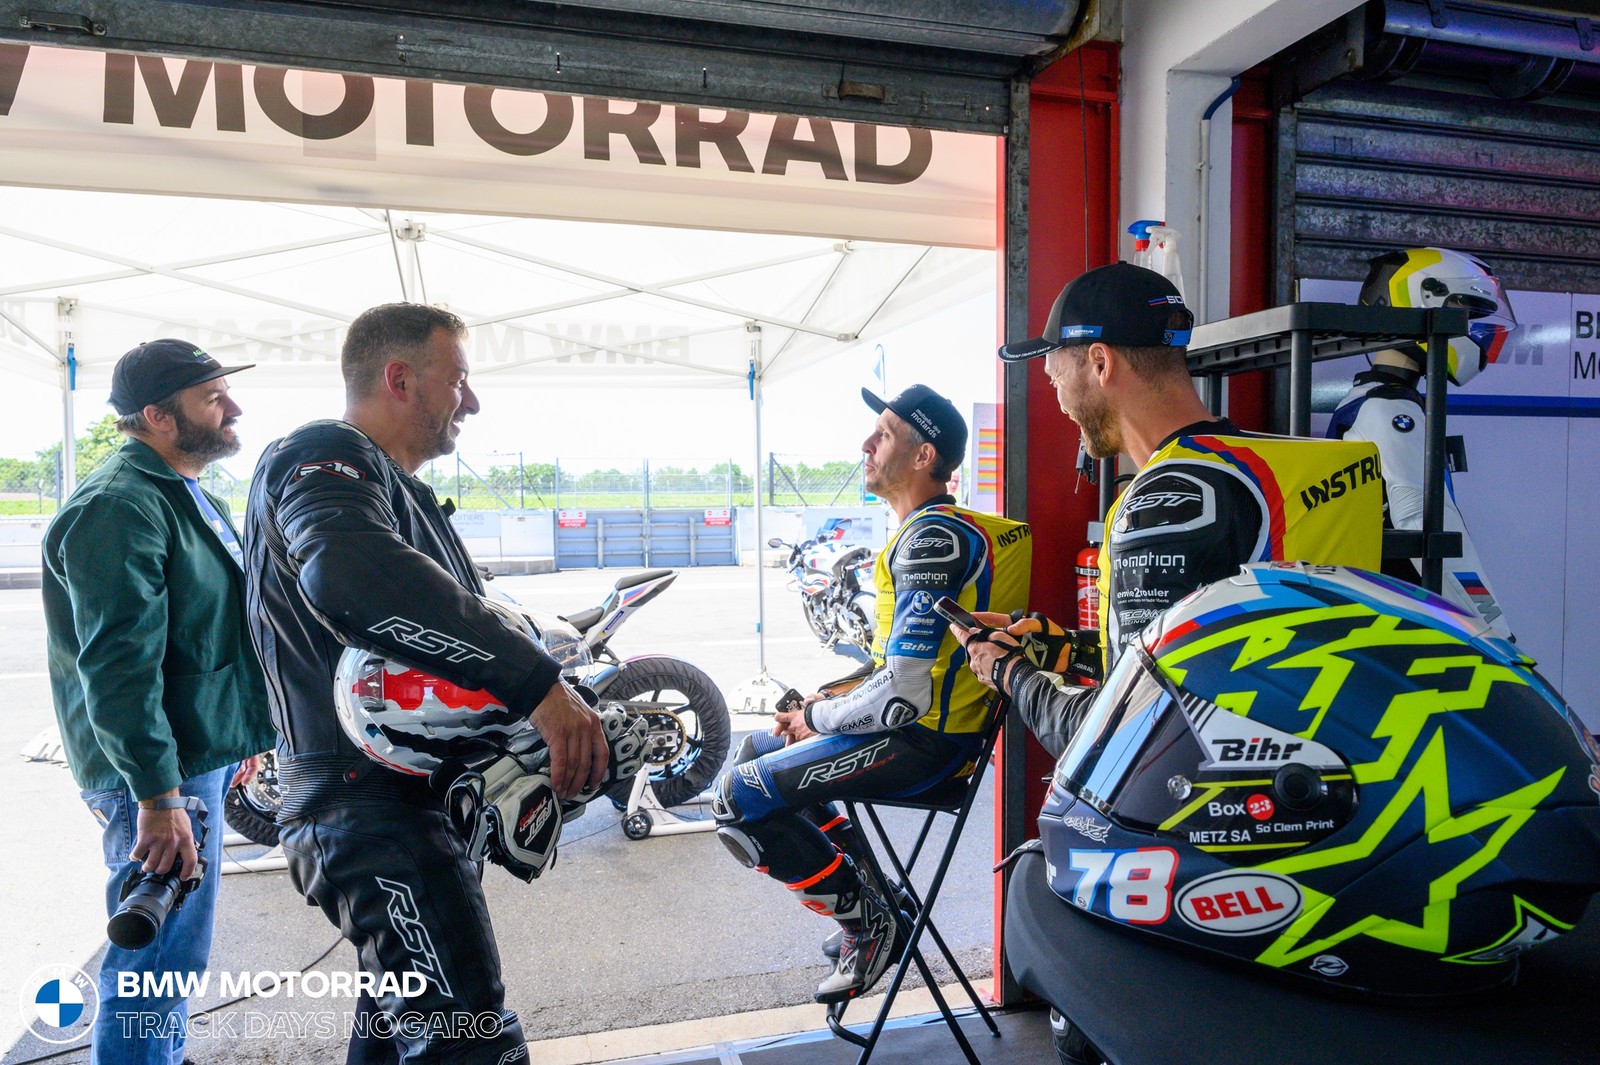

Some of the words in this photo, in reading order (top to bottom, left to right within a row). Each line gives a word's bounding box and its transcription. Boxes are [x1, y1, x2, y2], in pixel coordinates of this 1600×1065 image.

[1574, 351, 1600, 379] M
[910, 411, 938, 439] motards
[1117, 492, 1201, 520] RST
[904, 537, 953, 550] RST
[366, 616, 496, 663] RST
[899, 642, 934, 652] Bihr
[797, 737, 891, 790] RST
[1211, 738, 1303, 762] Bihr
[1208, 801, 1246, 817] Box
[1250, 800, 1271, 815] 23
[1189, 831, 1227, 844] METZ
[1230, 830, 1251, 843] SA
[1274, 822, 1303, 833] Clem
[1306, 819, 1335, 831] Print
[1069, 846, 1179, 925] 78
[1190, 886, 1285, 922] BELL
[375, 876, 453, 998] RST
